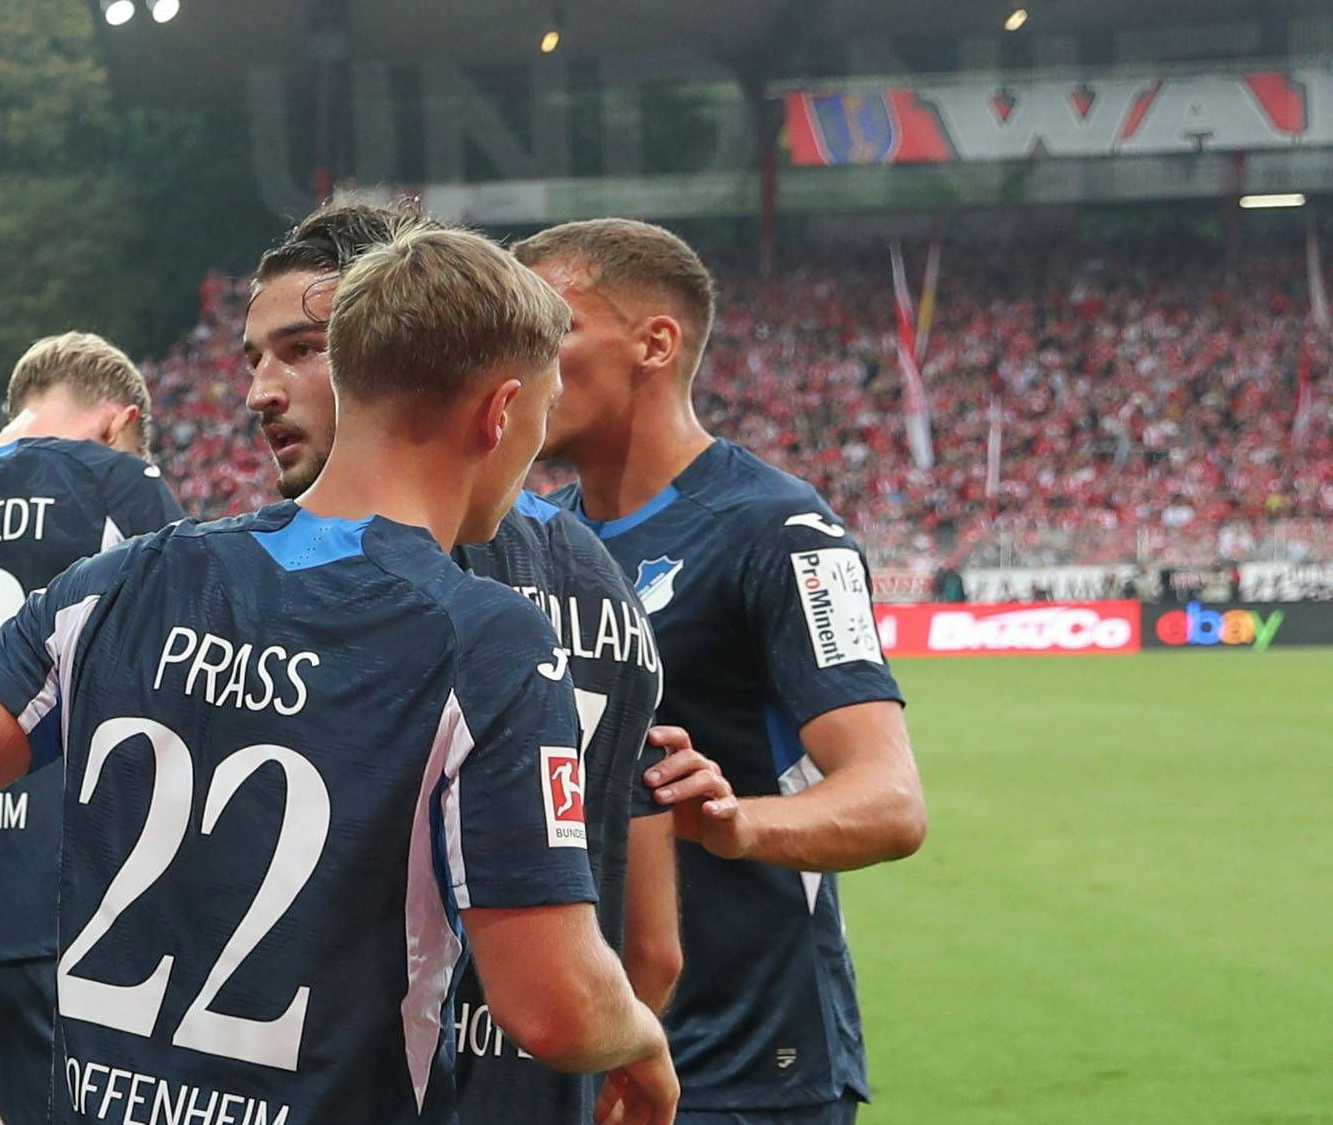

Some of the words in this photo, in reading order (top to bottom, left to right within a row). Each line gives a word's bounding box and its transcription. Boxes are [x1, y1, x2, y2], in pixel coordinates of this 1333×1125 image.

[799, 553, 846, 663] ProMinent
[1156, 600, 1284, 652] ebay
[153, 626, 320, 716] PRASS
[57, 717, 331, 1071] 22
